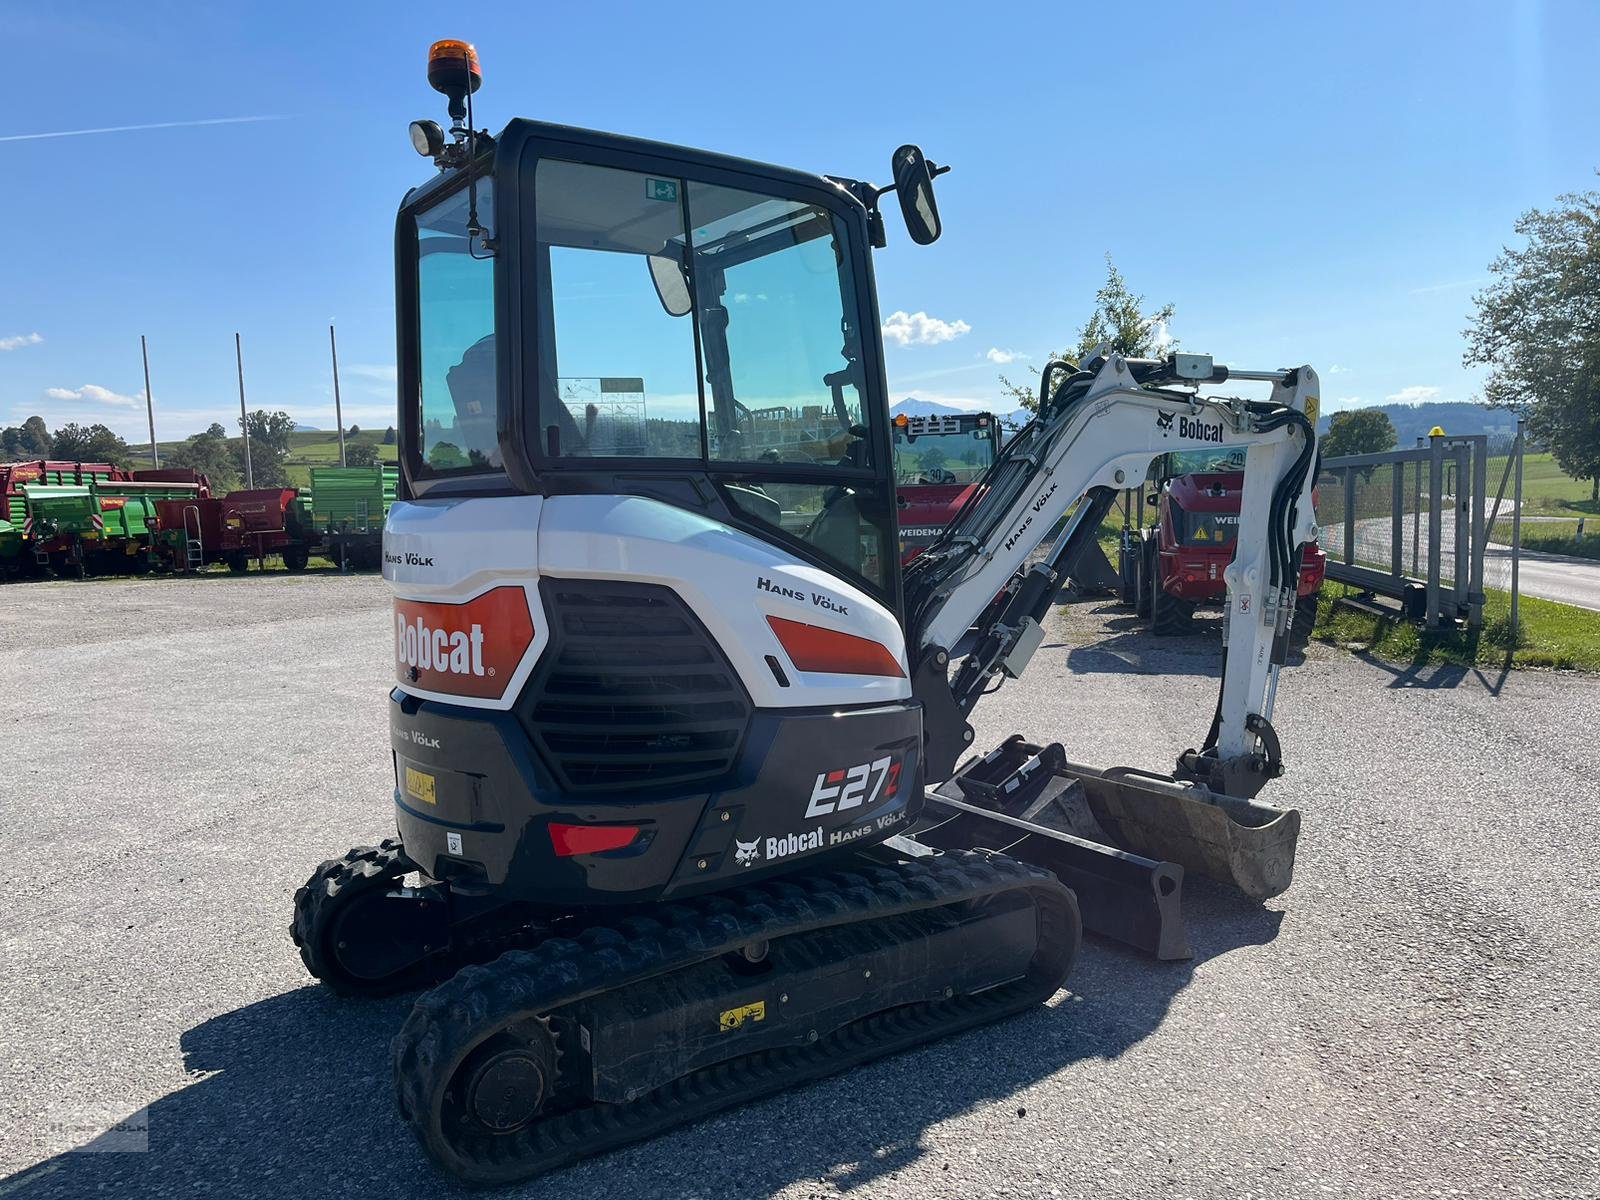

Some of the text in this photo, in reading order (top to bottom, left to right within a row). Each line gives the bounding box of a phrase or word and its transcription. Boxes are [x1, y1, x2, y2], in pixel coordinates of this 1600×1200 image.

[1180, 416, 1223, 443] Bobcat
[1231, 452, 1243, 465] 20
[930, 469, 942, 481] 30
[1004, 482, 1058, 551] HANS VÖLK
[899, 528, 958, 537] WEIDEMA
[405, 553, 433, 566] VÖLK
[757, 576, 848, 616] HANS VÖLK
[398, 613, 485, 676] Bobcat
[411, 730, 440, 748] VÖLK
[766, 811, 906, 860] Bobcat HANS VÖLK
